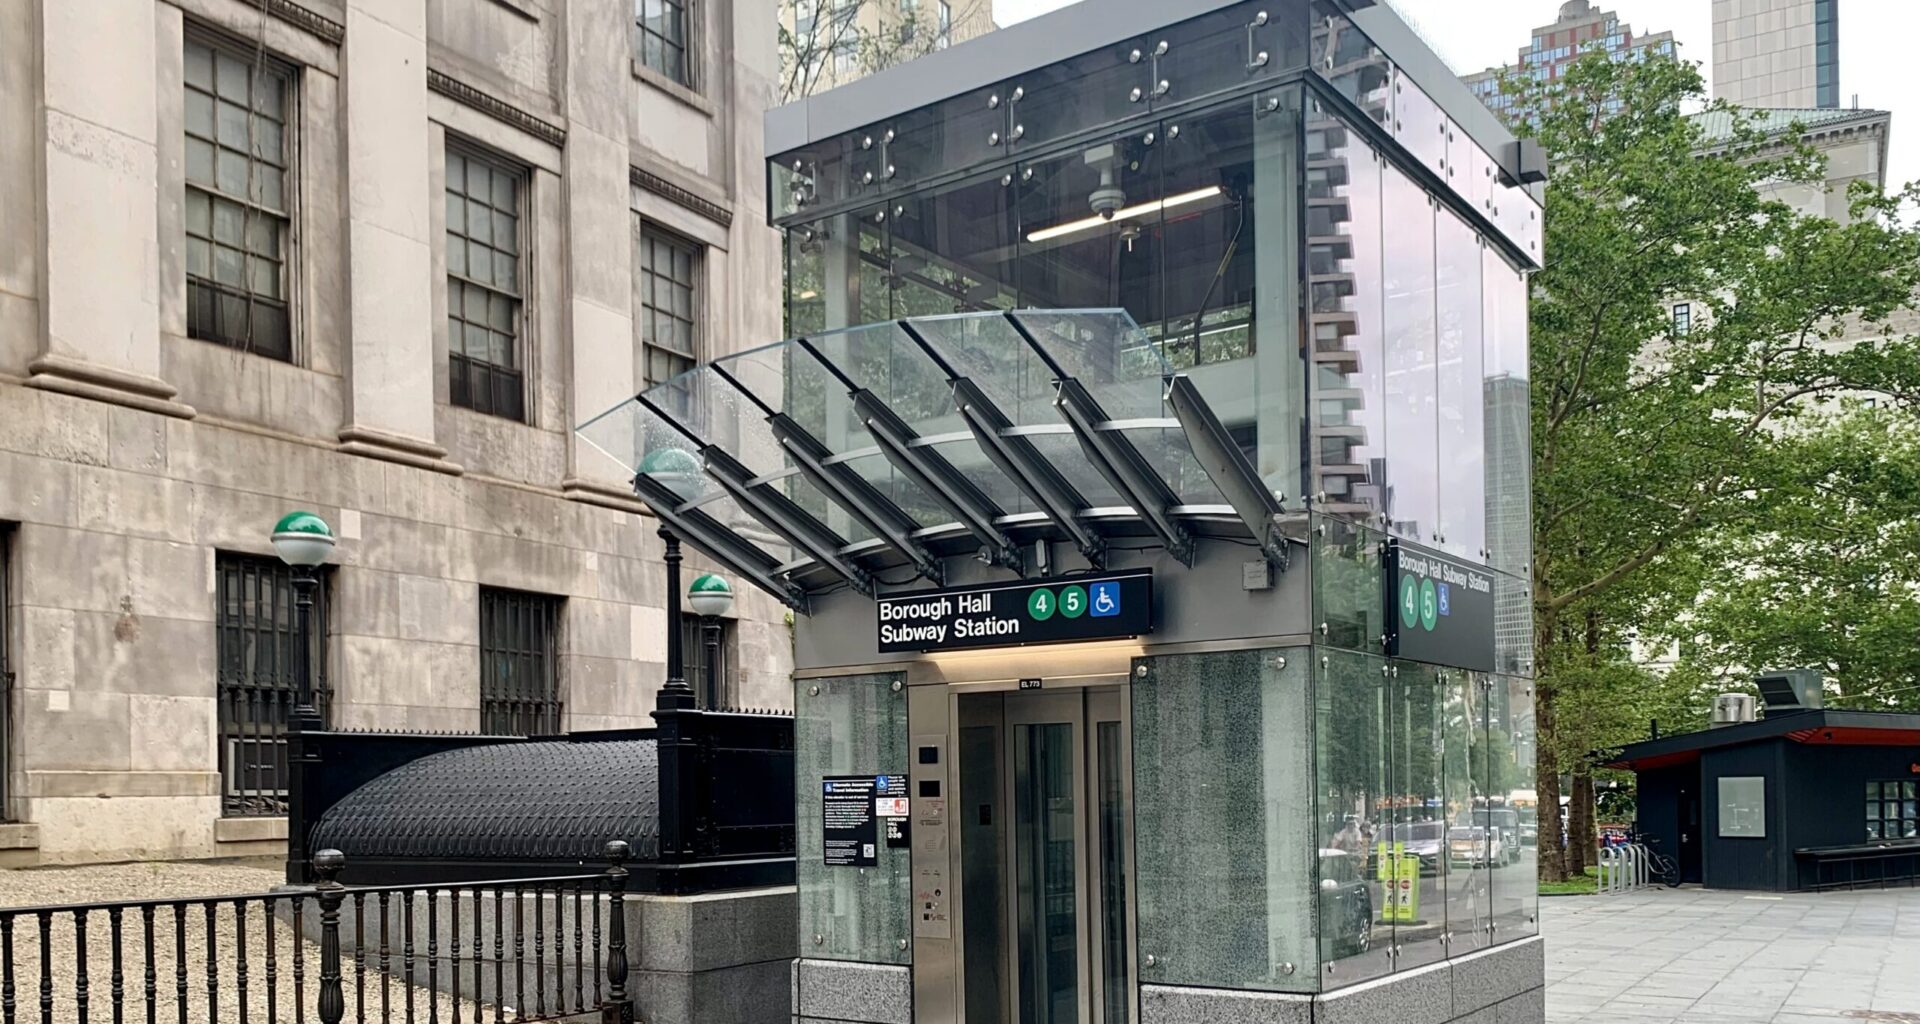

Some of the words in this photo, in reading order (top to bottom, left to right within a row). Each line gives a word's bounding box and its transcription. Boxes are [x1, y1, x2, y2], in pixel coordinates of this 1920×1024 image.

[1399, 550, 1428, 578] Borough
[1429, 559, 1442, 580] Hall
[1443, 564, 1467, 590] Subway
[1468, 571, 1490, 593] Station
[879, 597, 952, 621] Borough
[958, 593, 992, 614] Hall
[1035, 594, 1047, 613] 4
[1067, 592, 1078, 611] 5
[1405, 585, 1414, 615] 4
[1424, 590, 1433, 619] 5
[880, 624, 947, 643] Subway
[954, 616, 1019, 638] Station
